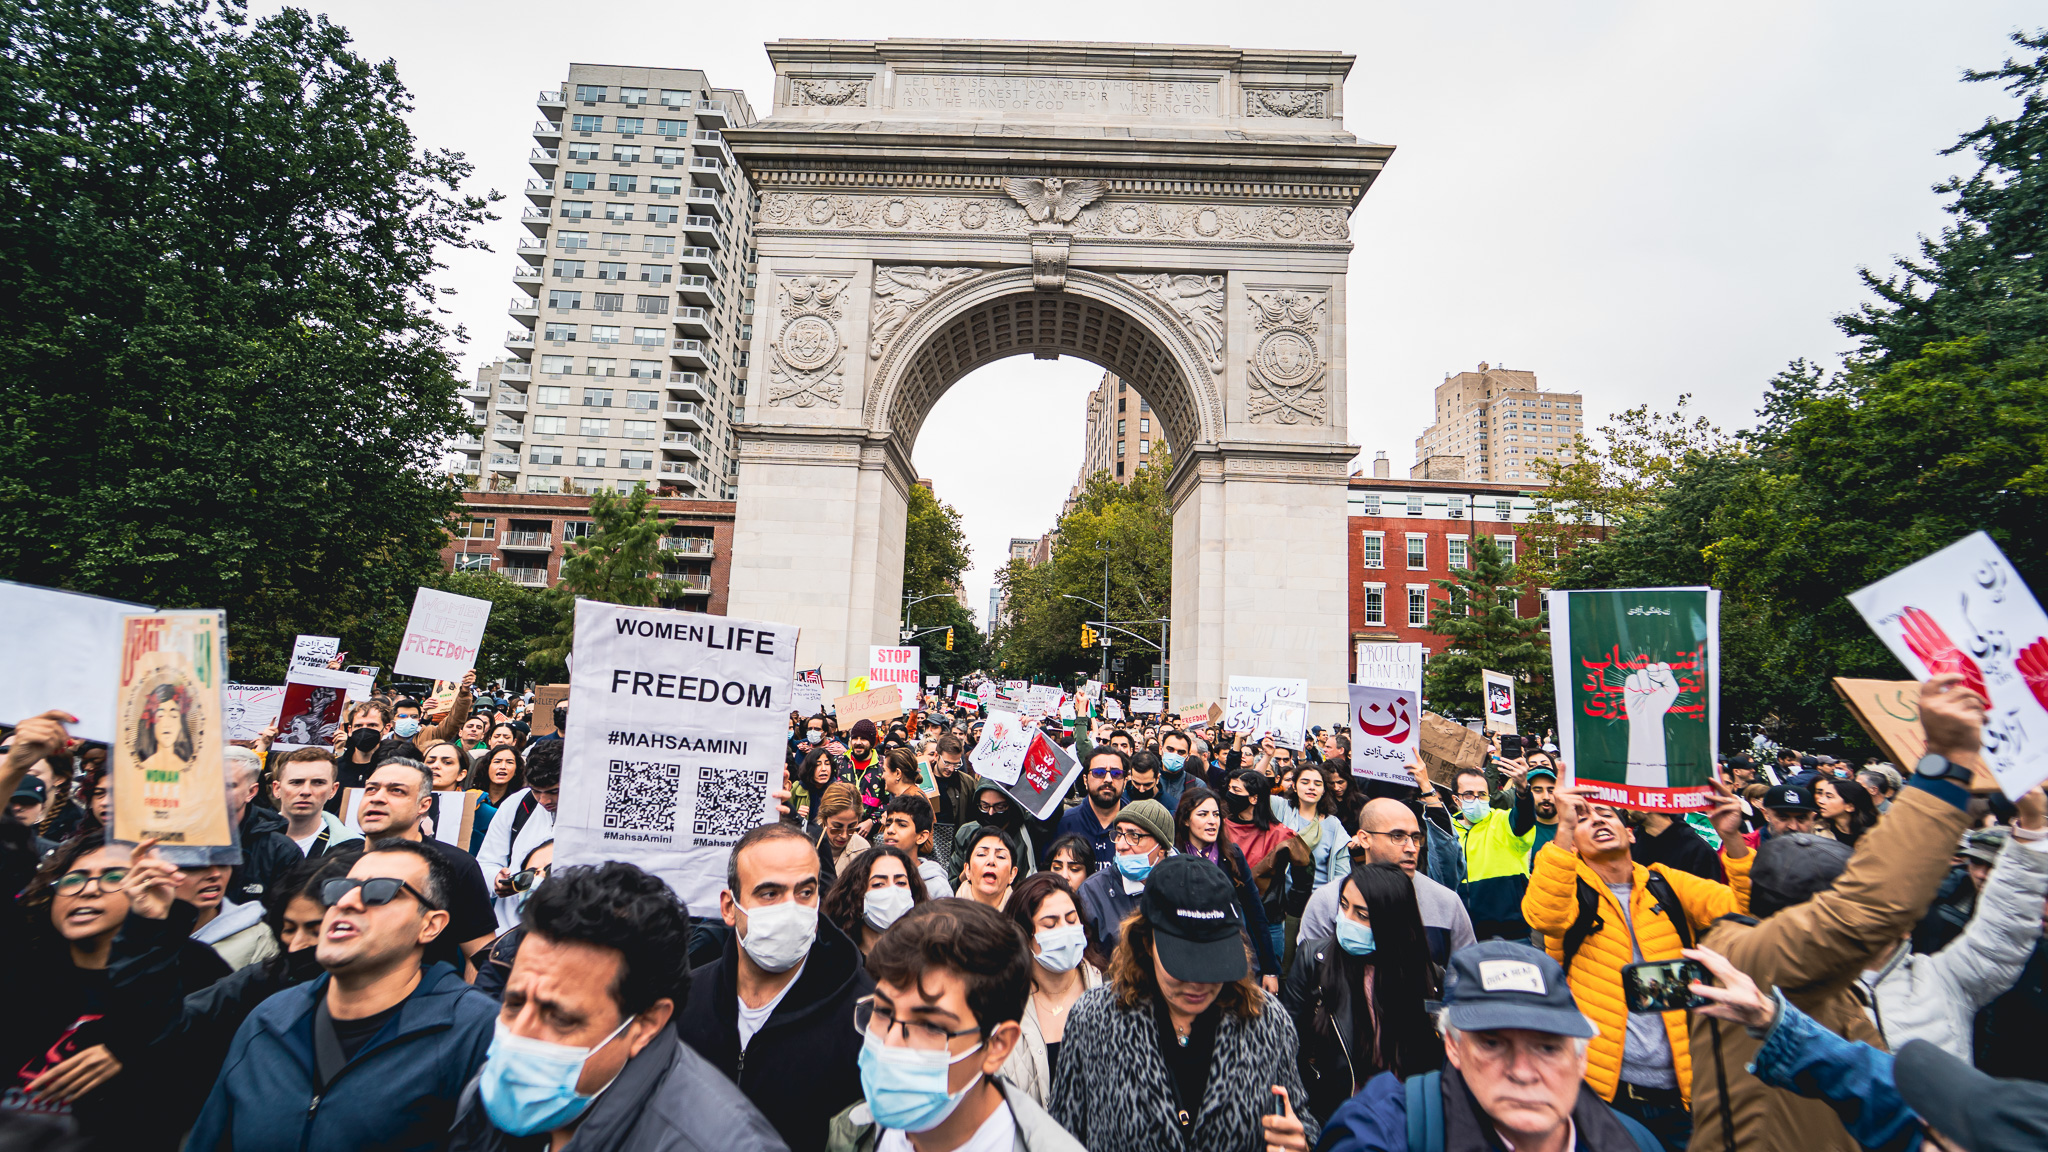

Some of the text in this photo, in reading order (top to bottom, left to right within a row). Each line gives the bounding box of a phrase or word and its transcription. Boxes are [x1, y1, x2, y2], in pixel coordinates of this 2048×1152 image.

[904, 76, 1210, 94] LET US RAISE A STANDARD TO WHICH THE WISE
[903, 87, 1211, 104] AND THE HONEST CAN REPAIR THE EVENT
[902, 97, 1211, 114] IS IN THE HAND OF GOD WASHINGTON
[421, 595, 488, 620] WOMEN
[422, 612, 474, 642] LIFE
[615, 617, 776, 655] WOMEN LIFE
[404, 633, 476, 663] FREEDOM
[878, 648, 912, 664] STOP
[1359, 644, 1413, 663] PROTECT
[297, 654, 330, 664] WOMAN
[870, 667, 919, 684] KILLING
[1358, 663, 1416, 680] IRANIAN
[611, 669, 772, 709] FREEDOM
[1010, 681, 1023, 689] NO
[1230, 685, 1261, 693] woman
[1276, 682, 1299, 698] زن
[1179, 702, 1204, 712] WOMEN
[1229, 694, 1249, 709] Life
[1181, 713, 1208, 724] FREEDOM
[1358, 696, 1411, 745] زن
[607, 730, 748, 756] #MAHSAAMINI
[1353, 767, 1374, 776] WOMAN
[1377, 771, 1389, 779] LIFE
[1638, 792, 1667, 808] LIFE
[603, 831, 673, 844] #MahsaAmini
[1176, 908, 1225, 919] unsubscribe
